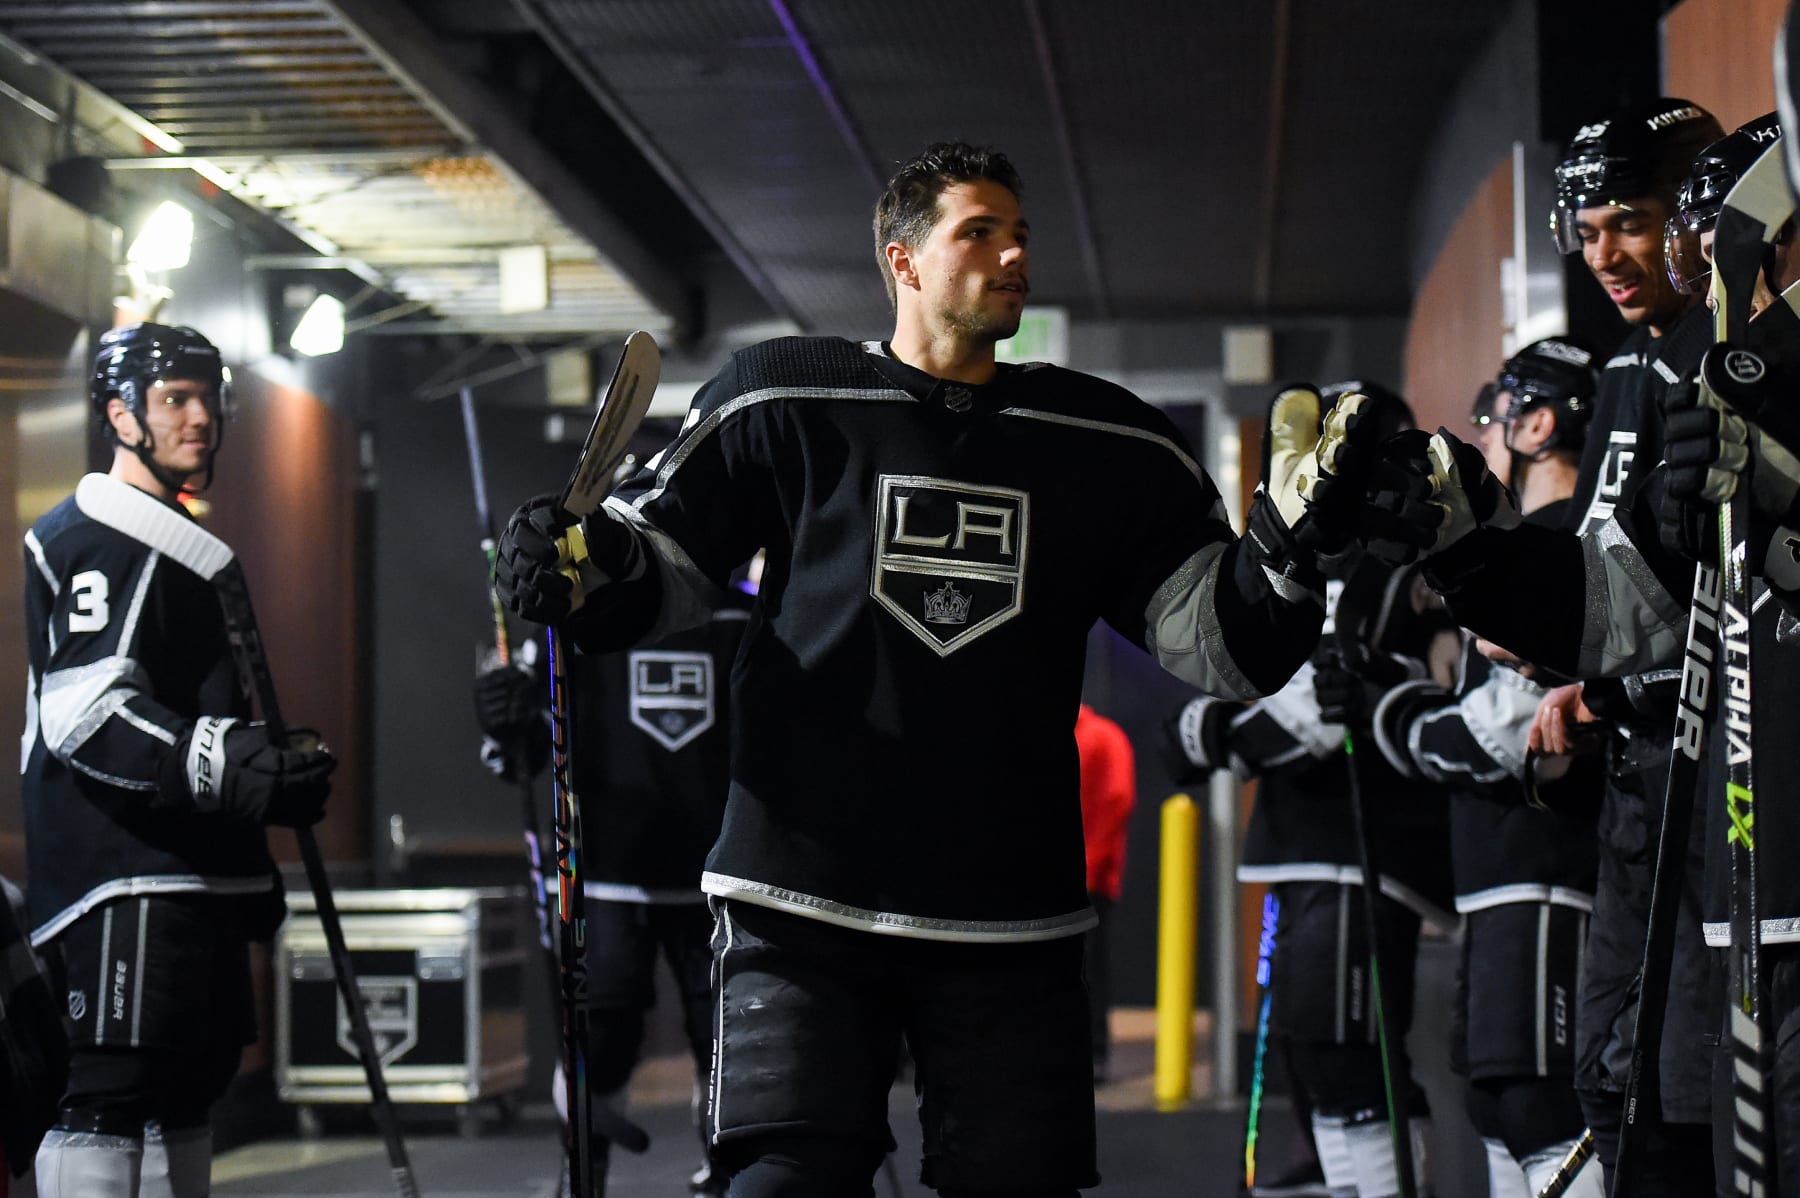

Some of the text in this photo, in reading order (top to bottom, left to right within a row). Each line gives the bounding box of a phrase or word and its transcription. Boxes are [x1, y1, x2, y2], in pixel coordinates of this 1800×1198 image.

[892, 496, 1015, 556] LA
[69, 570, 110, 632] 3
[639, 662, 704, 693] LA
[1673, 561, 1721, 761] AUER
[113, 960, 127, 1020] BAUER
